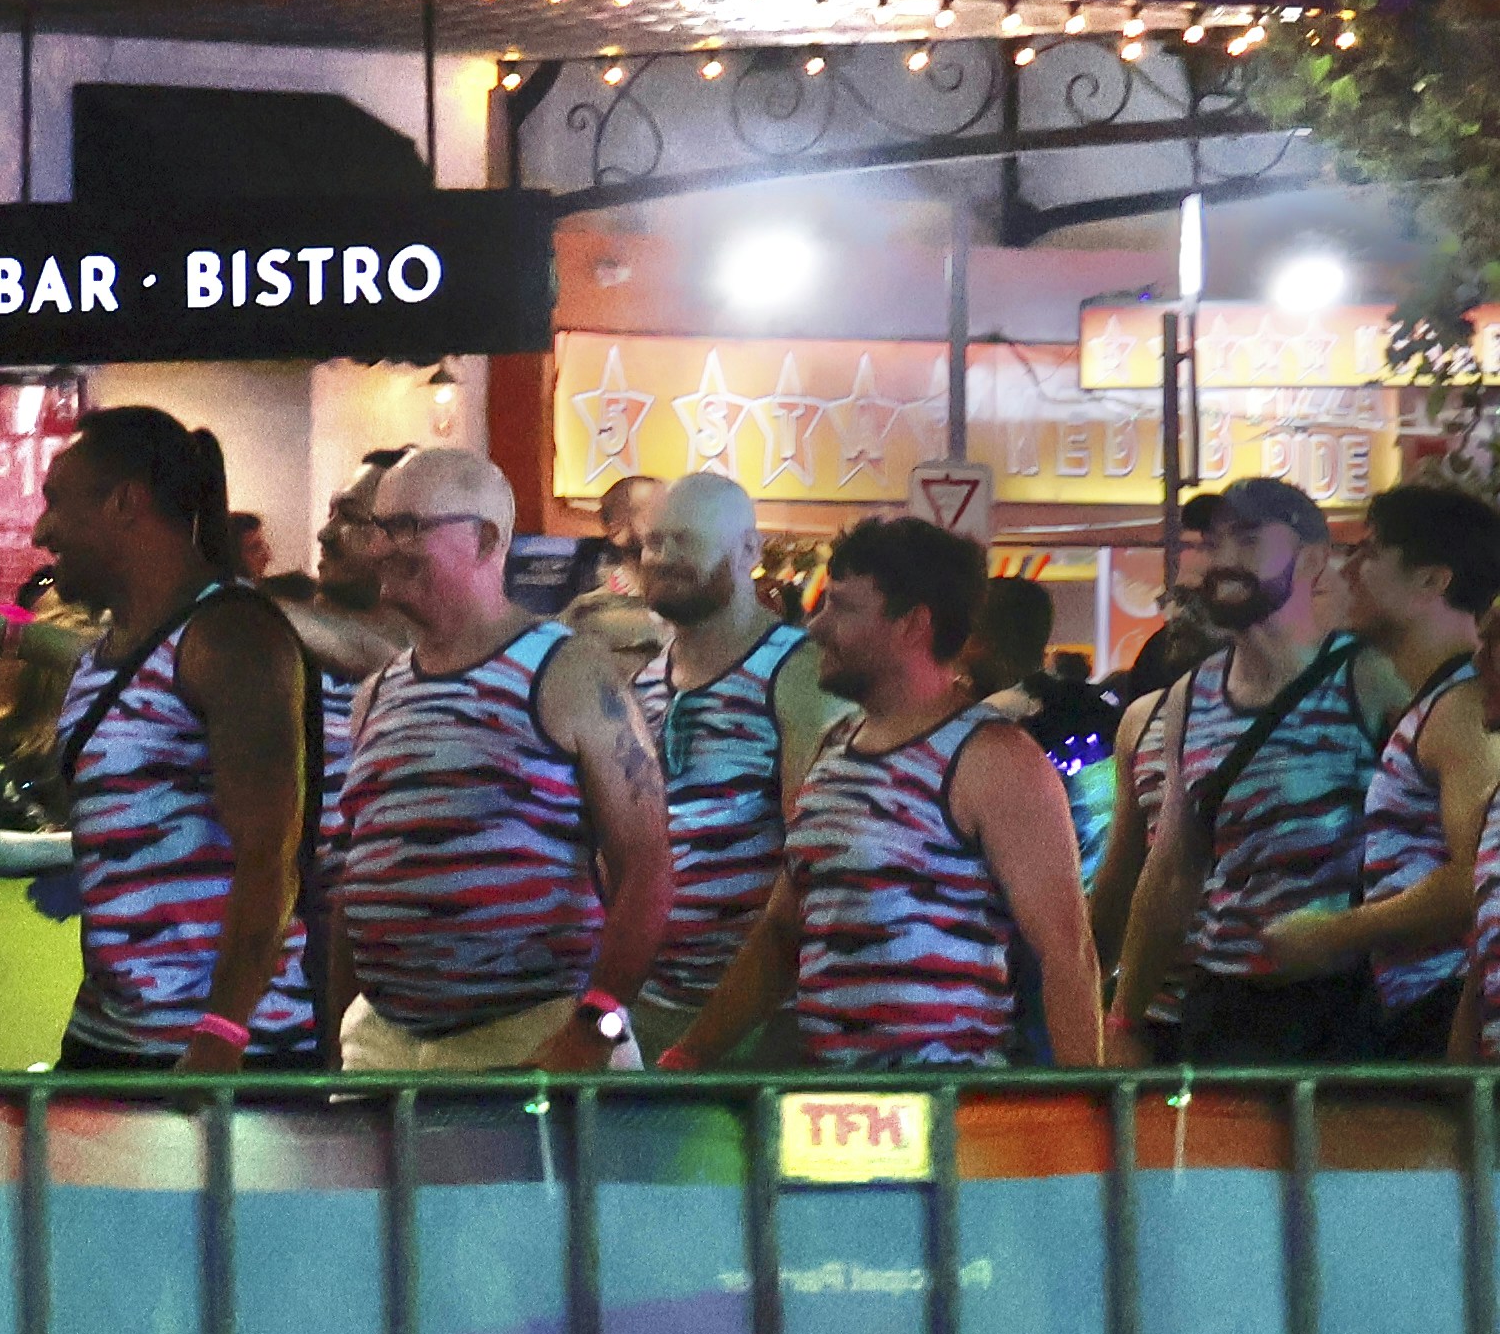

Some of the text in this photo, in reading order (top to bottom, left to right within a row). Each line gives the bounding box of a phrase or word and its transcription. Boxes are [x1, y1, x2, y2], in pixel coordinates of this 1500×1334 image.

[187, 244, 442, 309] BISTRO
[1007, 412, 1232, 481] KEBB
[801, 1103, 906, 1147] TFH
